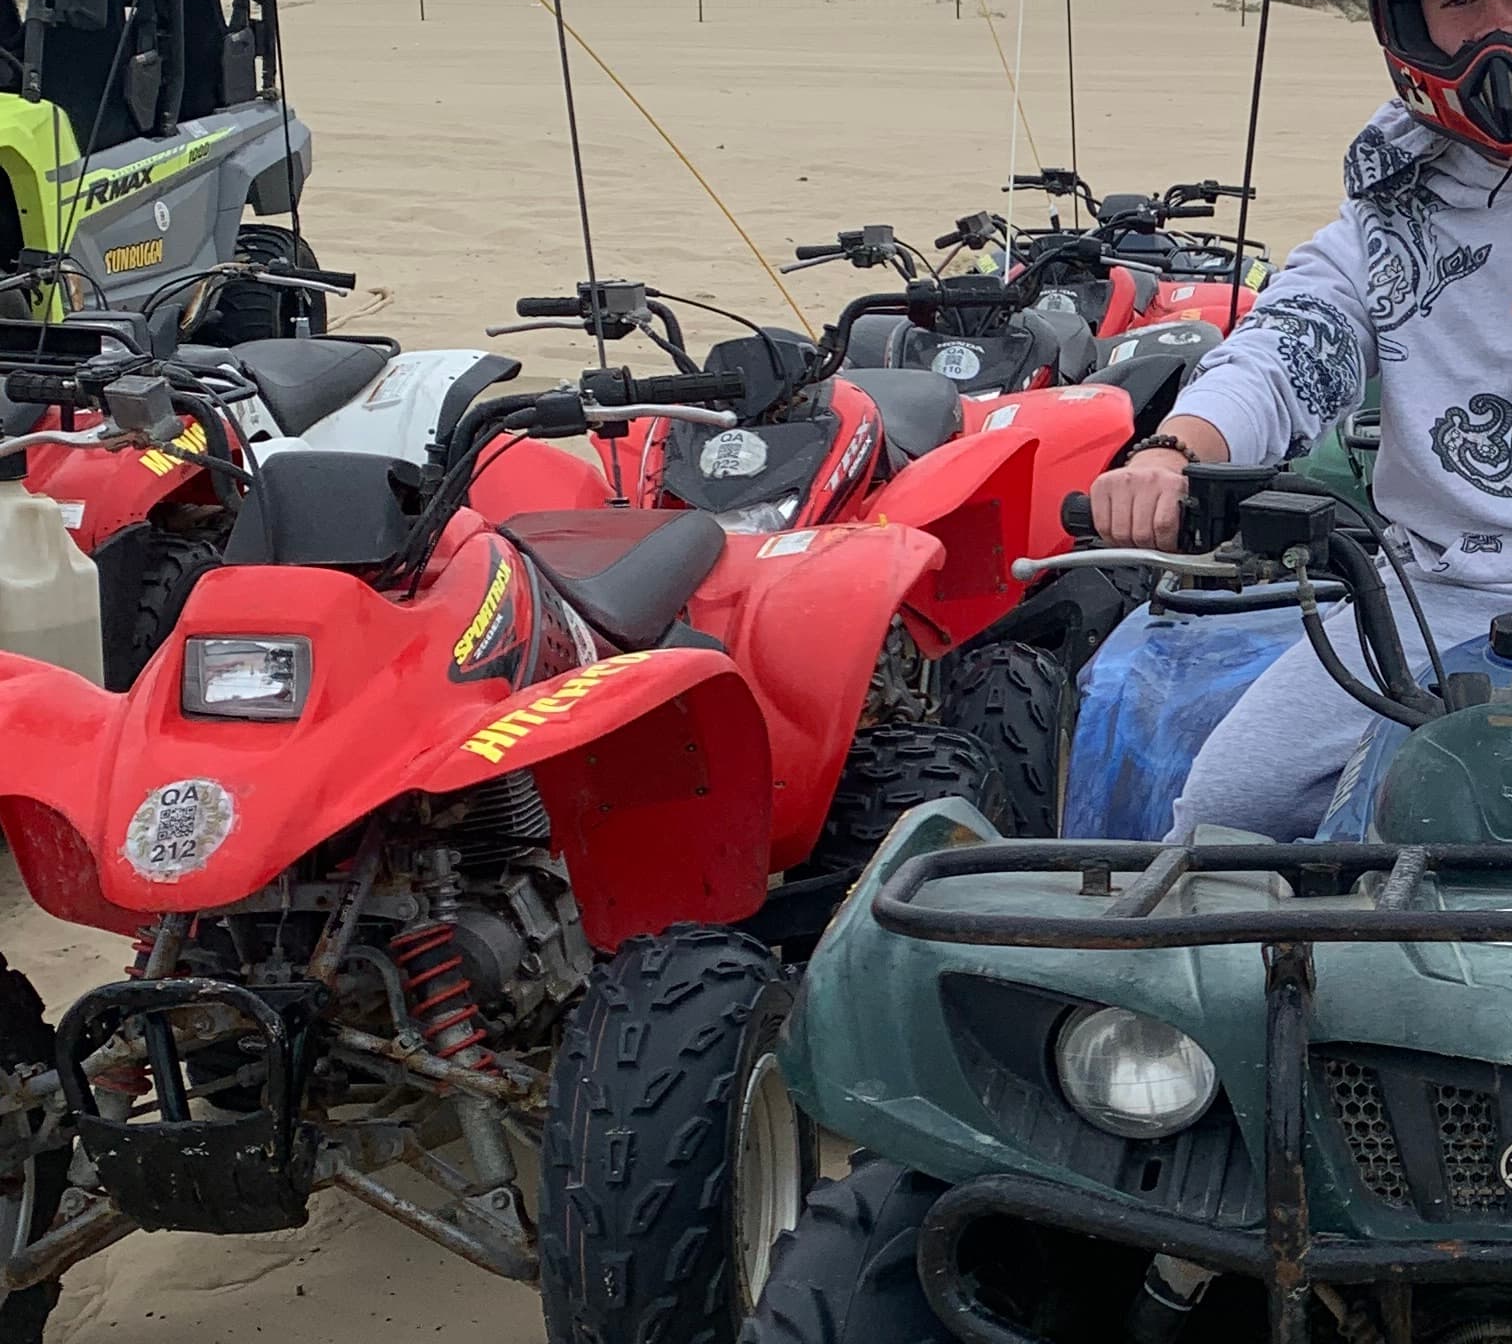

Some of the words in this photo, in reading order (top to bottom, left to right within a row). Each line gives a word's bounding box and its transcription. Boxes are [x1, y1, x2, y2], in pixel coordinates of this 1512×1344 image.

[104, 238, 164, 275] SUNBUGGY
[937, 341, 985, 354] HONDA
[720, 432, 744, 443] QA
[161, 785, 199, 806] QA
[150, 839, 197, 863] 212
